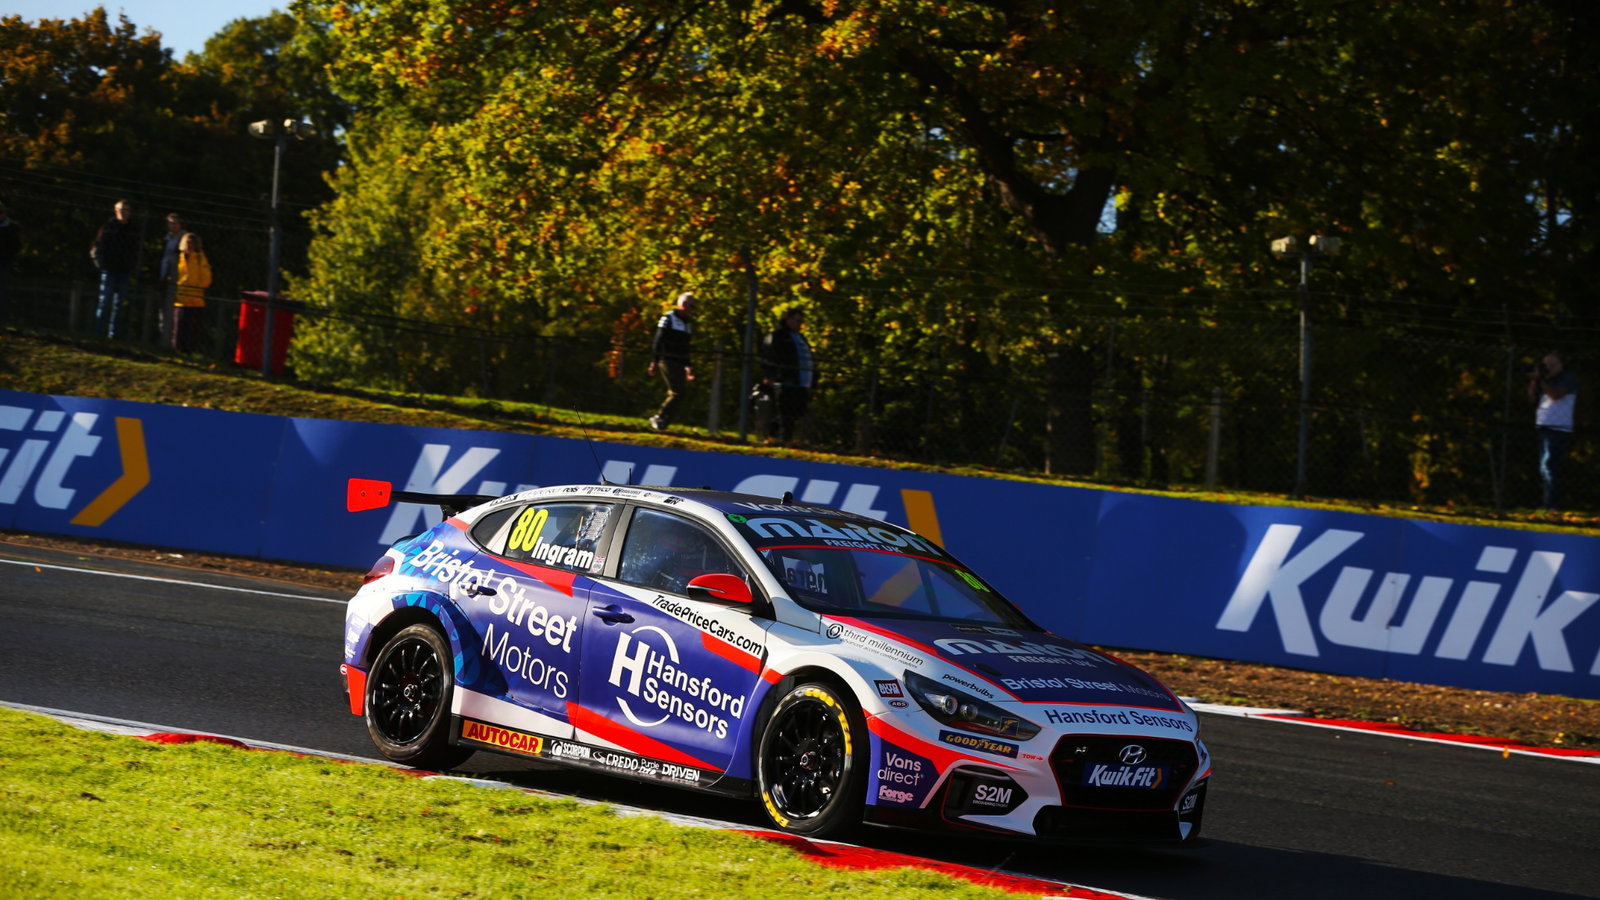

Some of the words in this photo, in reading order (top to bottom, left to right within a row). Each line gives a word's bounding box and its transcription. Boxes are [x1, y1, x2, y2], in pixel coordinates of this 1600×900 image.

[509, 507, 549, 552] 80
[531, 541, 594, 570] Ingram
[824, 539, 883, 551] FREIGHT
[884, 545, 903, 554] UK
[409, 540, 495, 602] Bristol
[489, 577, 577, 654] Street
[1215, 523, 1600, 673] Kwik
[652, 595, 762, 656] TradePriceCars.com
[843, 628, 868, 643] third
[868, 638, 924, 667] millennium
[481, 623, 568, 698] Motors
[1008, 655, 1070, 665] FREIGHT
[647, 650, 745, 719] Hansford
[942, 673, 995, 699] powerbulbs
[1000, 678, 1065, 691] Bristol
[1069, 678, 1122, 692] Street
[643, 677, 729, 739] Sensors
[1044, 709, 1129, 726] Hansford
[1130, 711, 1193, 732] Sensors
[466, 722, 540, 753] AUTOCAR
[945, 734, 1013, 754] GOODYEAR
[562, 742, 591, 759] SCORPION
[605, 753, 639, 771] CREDO
[886, 752, 922, 772] Vans
[661, 763, 700, 782] DRIVEN
[877, 767, 920, 786] direct
[975, 784, 1012, 804] S2M
